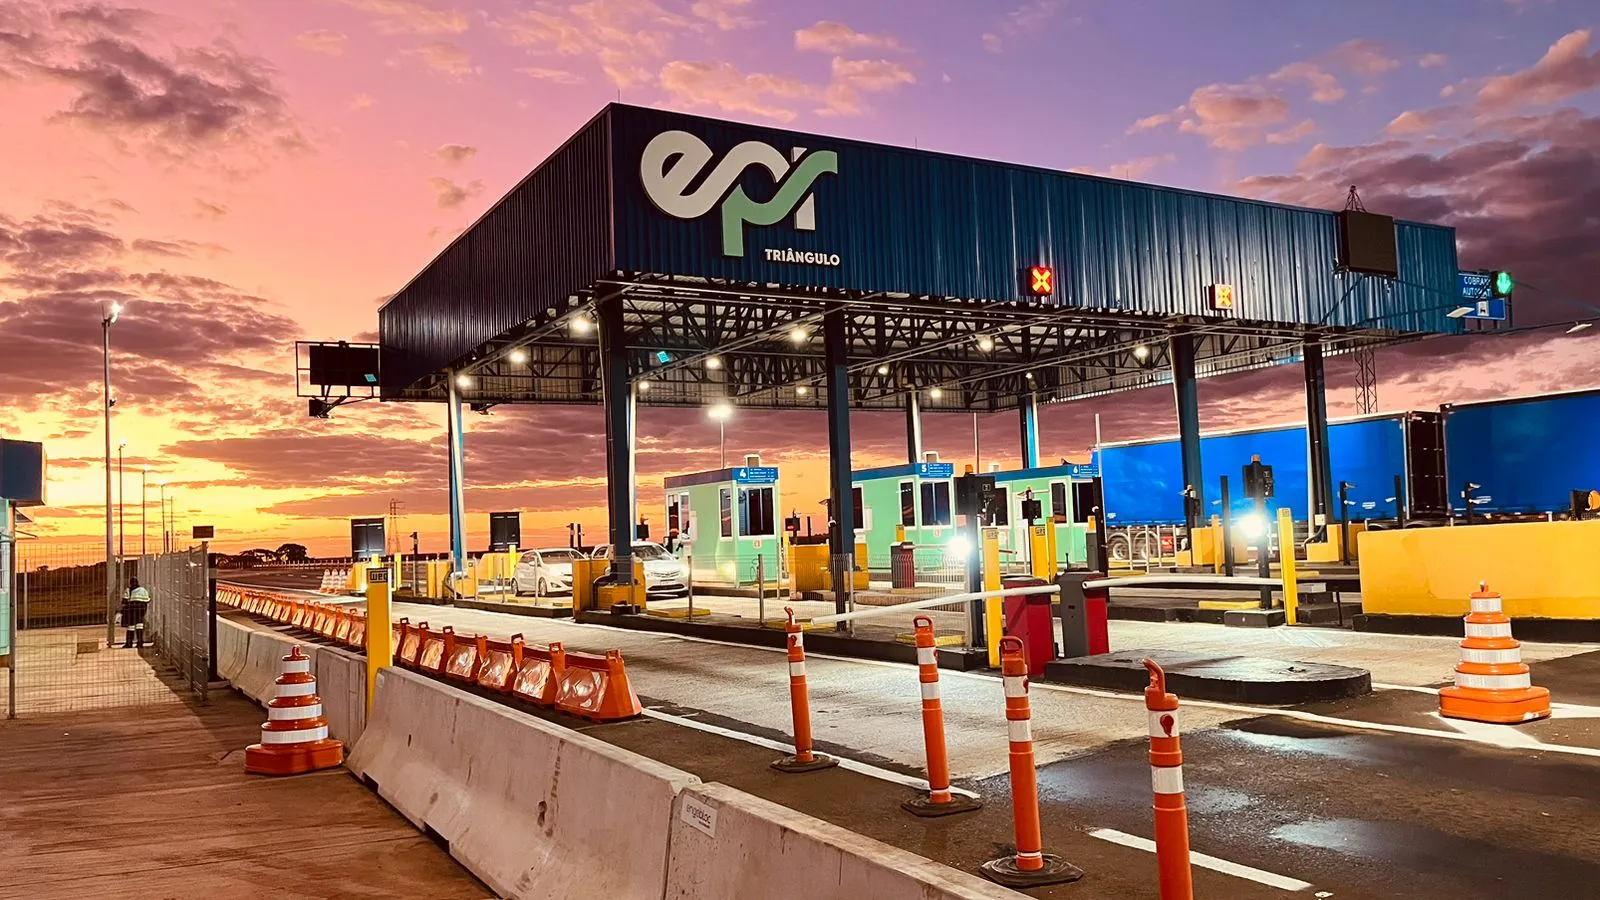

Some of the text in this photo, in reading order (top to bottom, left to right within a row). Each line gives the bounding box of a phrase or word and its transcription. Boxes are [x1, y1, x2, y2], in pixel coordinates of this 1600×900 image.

[765, 248, 840, 266] TRIÂNGULO
[739, 468, 747, 478] 4
[921, 464, 927, 473] 5
[1073, 465, 1079, 474] 6
